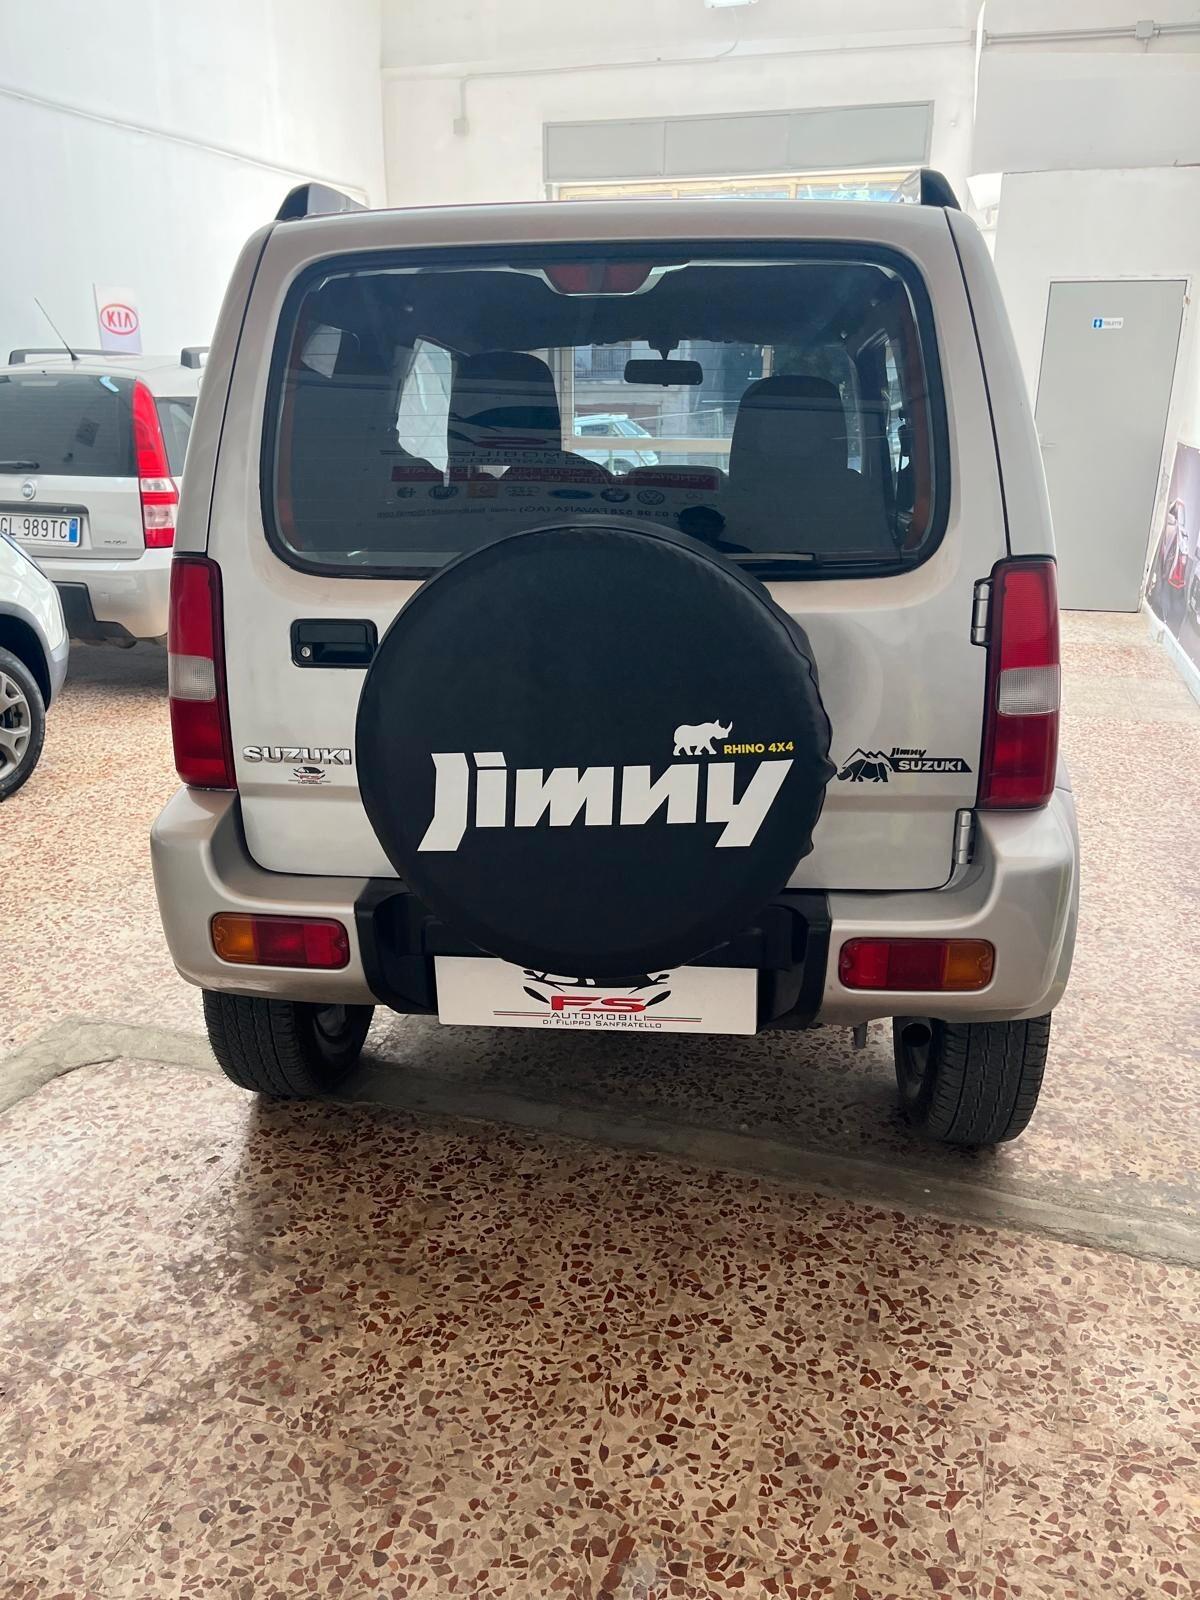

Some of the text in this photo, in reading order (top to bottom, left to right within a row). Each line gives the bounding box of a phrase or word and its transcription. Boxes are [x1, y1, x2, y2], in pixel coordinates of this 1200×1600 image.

[107, 311, 133, 328] KIA
[723, 741, 794, 754] RHINO 4X4
[242, 745, 353, 765] SUZUKI
[898, 760, 962, 771] SUZUKI
[551, 996, 647, 1013] FS
[551, 1012, 647, 1021] AUTOMOBILI
[556, 1019, 591, 1027] FILIPPO
[595, 1020, 662, 1029] SANFRATELLO
